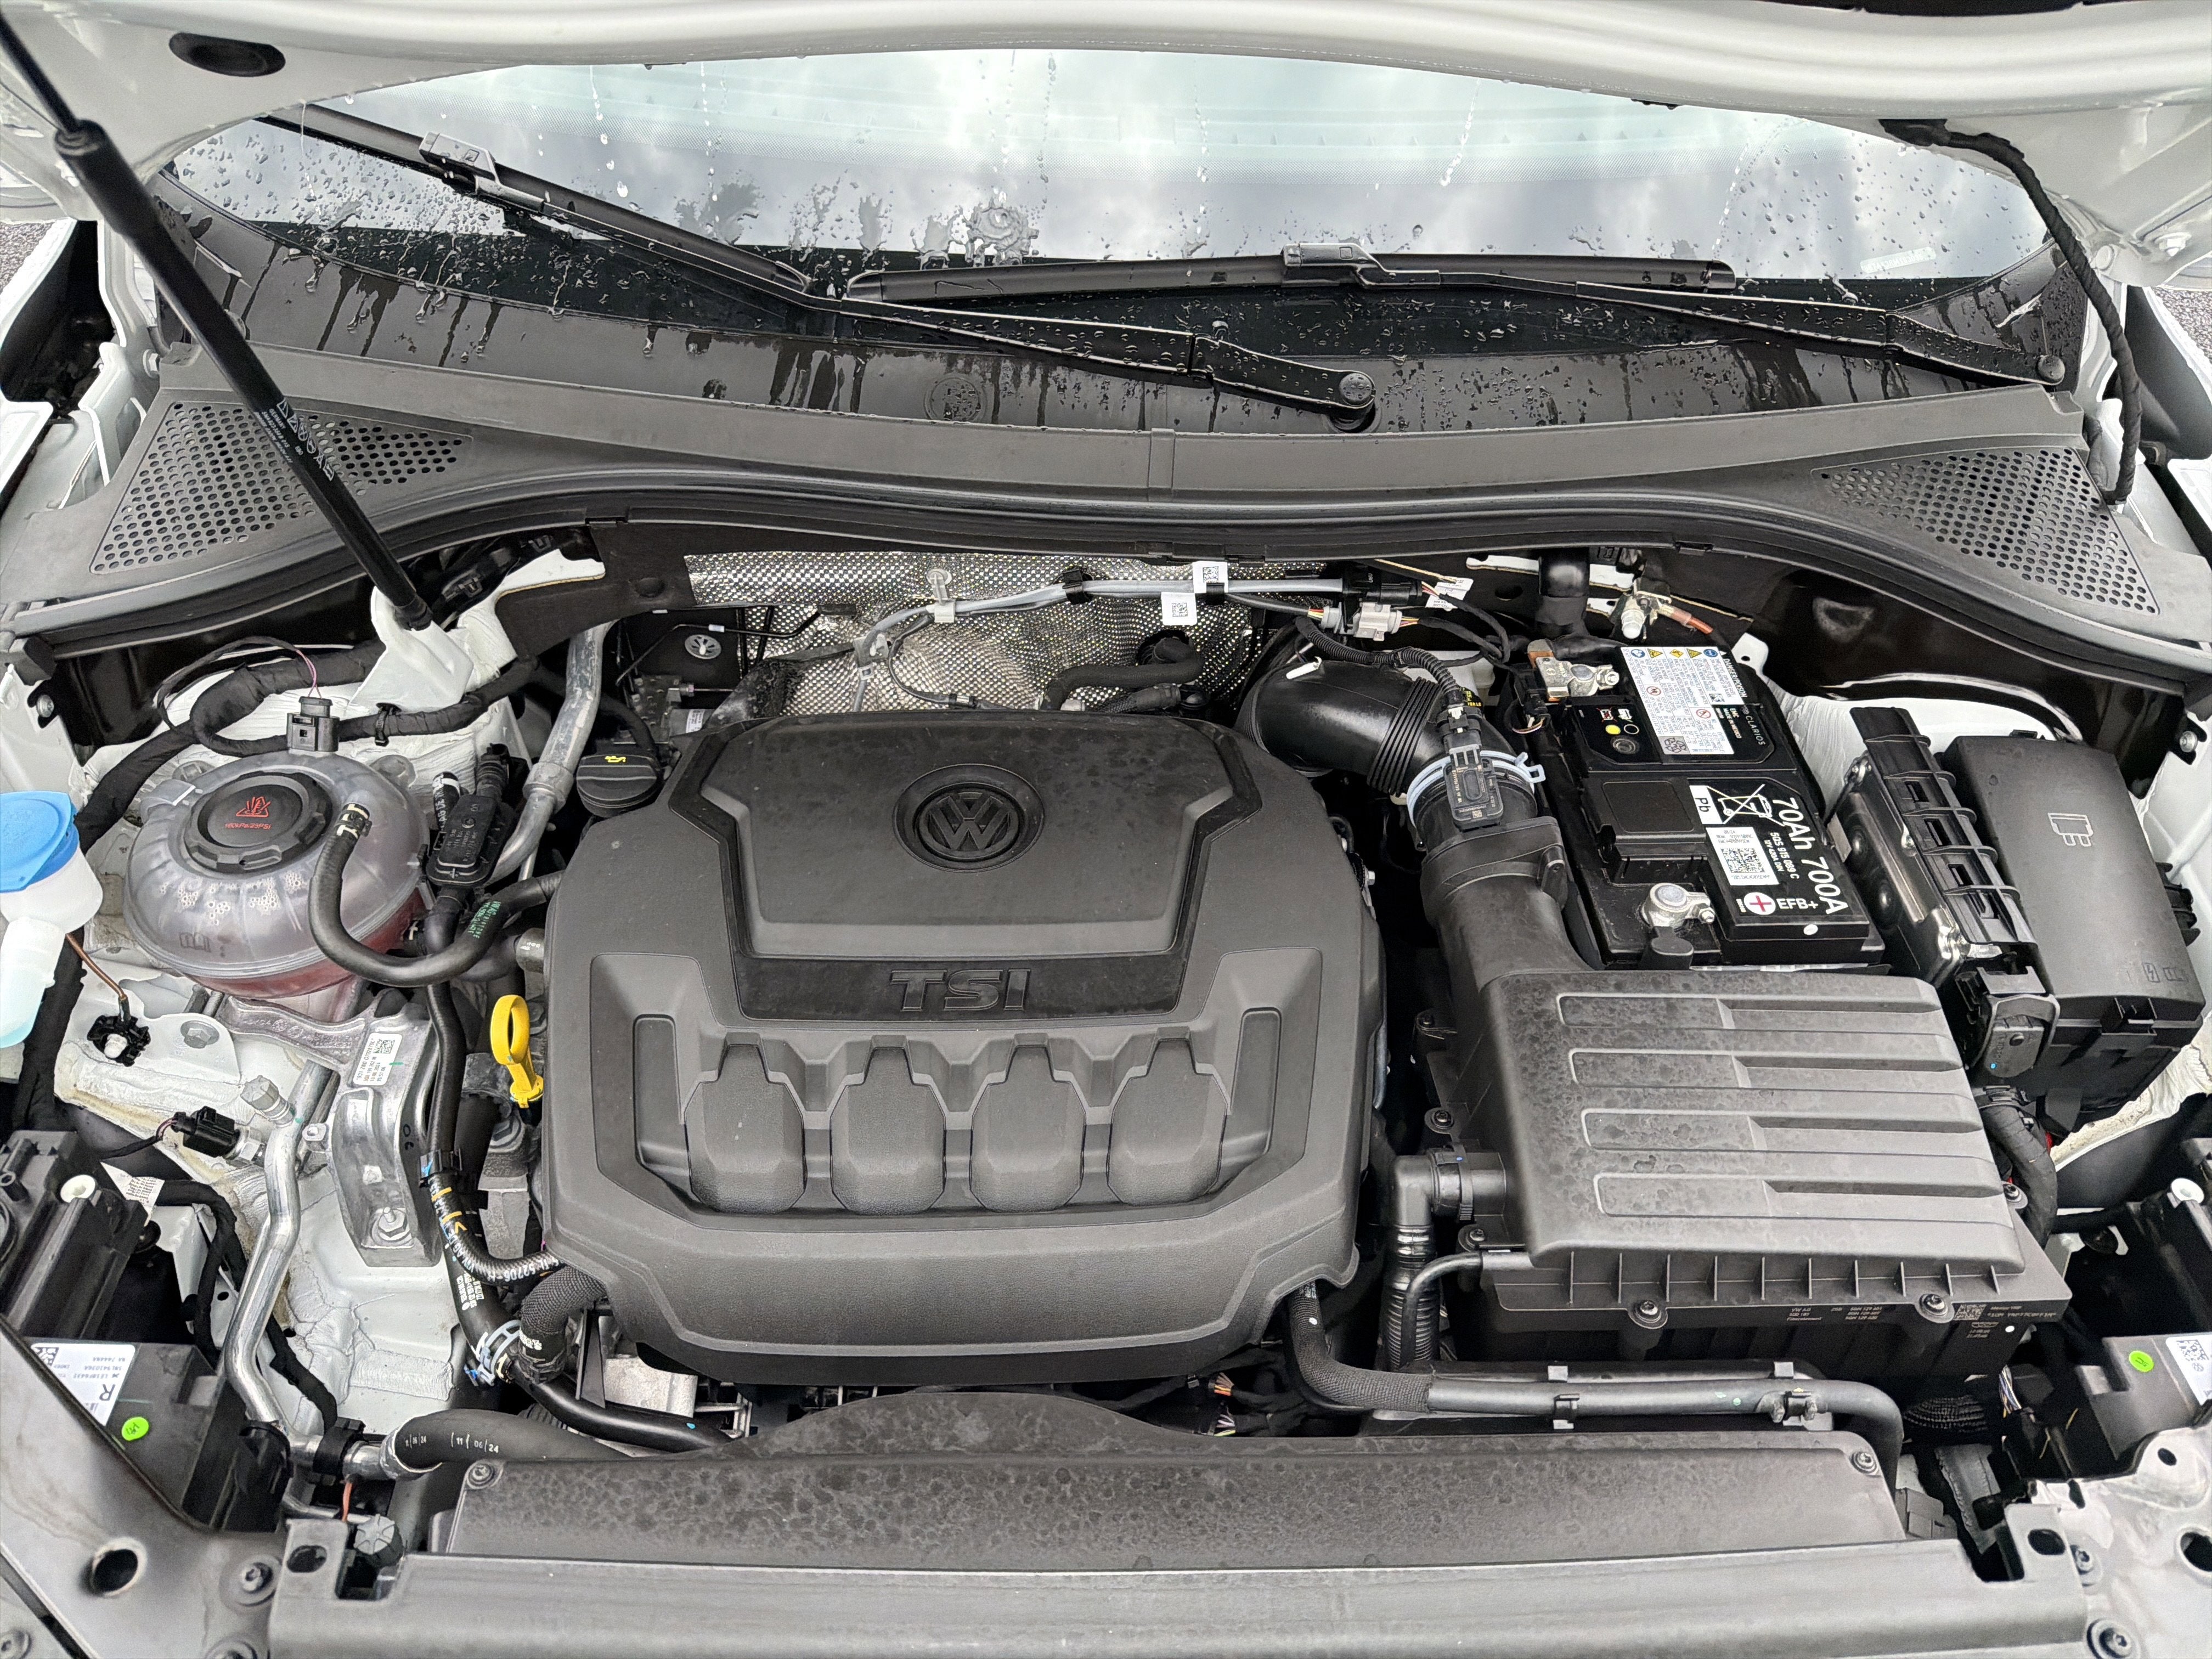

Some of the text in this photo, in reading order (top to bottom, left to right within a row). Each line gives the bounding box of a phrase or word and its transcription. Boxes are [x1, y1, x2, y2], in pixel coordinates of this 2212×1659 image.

[269, 408, 286, 428] GERMANY
[1722, 708, 1733, 719] MADE
[1730, 724, 1742, 738] MEXICO
[1744, 715, 1766, 744] CLARIOS
[1695, 797, 1710, 813] Pb
[1773, 797, 1848, 916] 70Ah 700A
[1777, 848, 1790, 859] 915
[1774, 862, 1784, 871] DIN
[1782, 860, 1796, 872] 089
[1777, 897, 1819, 910] EFB+
[890, 968, 1031, 1012] TSI
[99, 1384, 115, 1401] R
[456, 1437, 462, 1445] 11
[488, 1443, 499, 1453] 24
